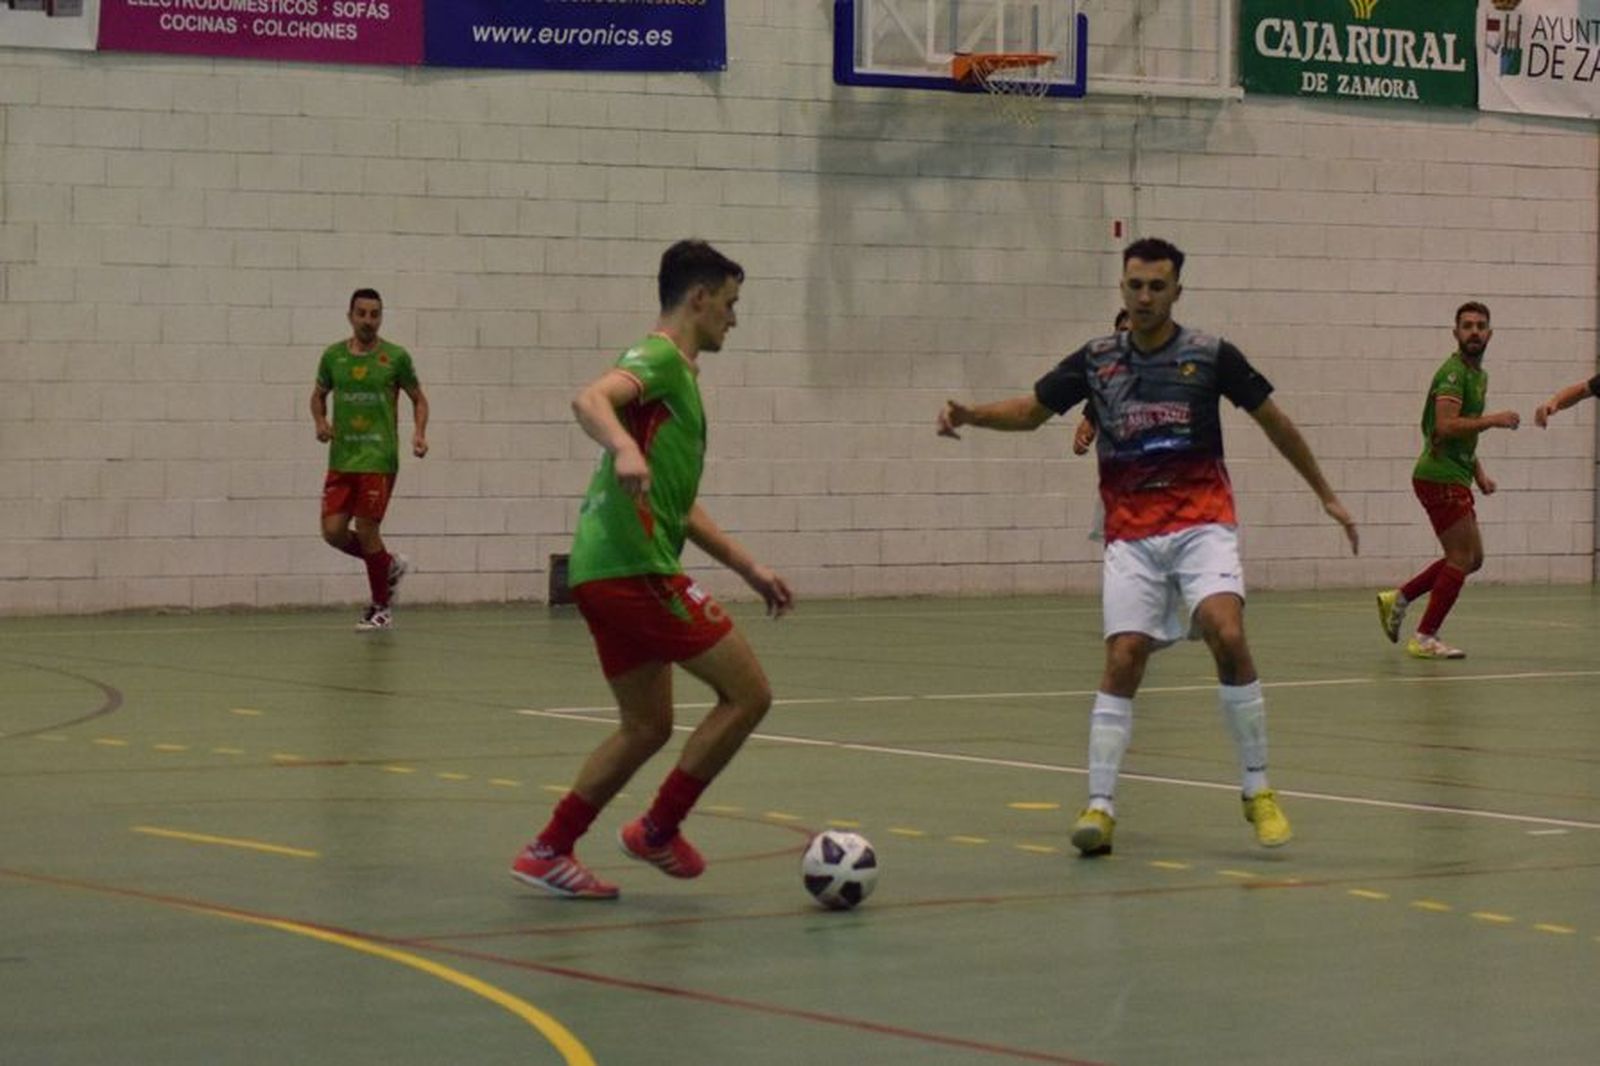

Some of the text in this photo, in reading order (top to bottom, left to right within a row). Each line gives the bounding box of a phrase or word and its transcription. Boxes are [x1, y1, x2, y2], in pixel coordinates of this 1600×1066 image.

[332, 0, 390, 19] SOFÁS
[160, 14, 358, 39] COCINAS COLCHONES
[472, 24, 673, 46] www.euronics.es
[1527, 43, 1565, 79] DE
[1302, 72, 1419, 100] DE ZAMORA
